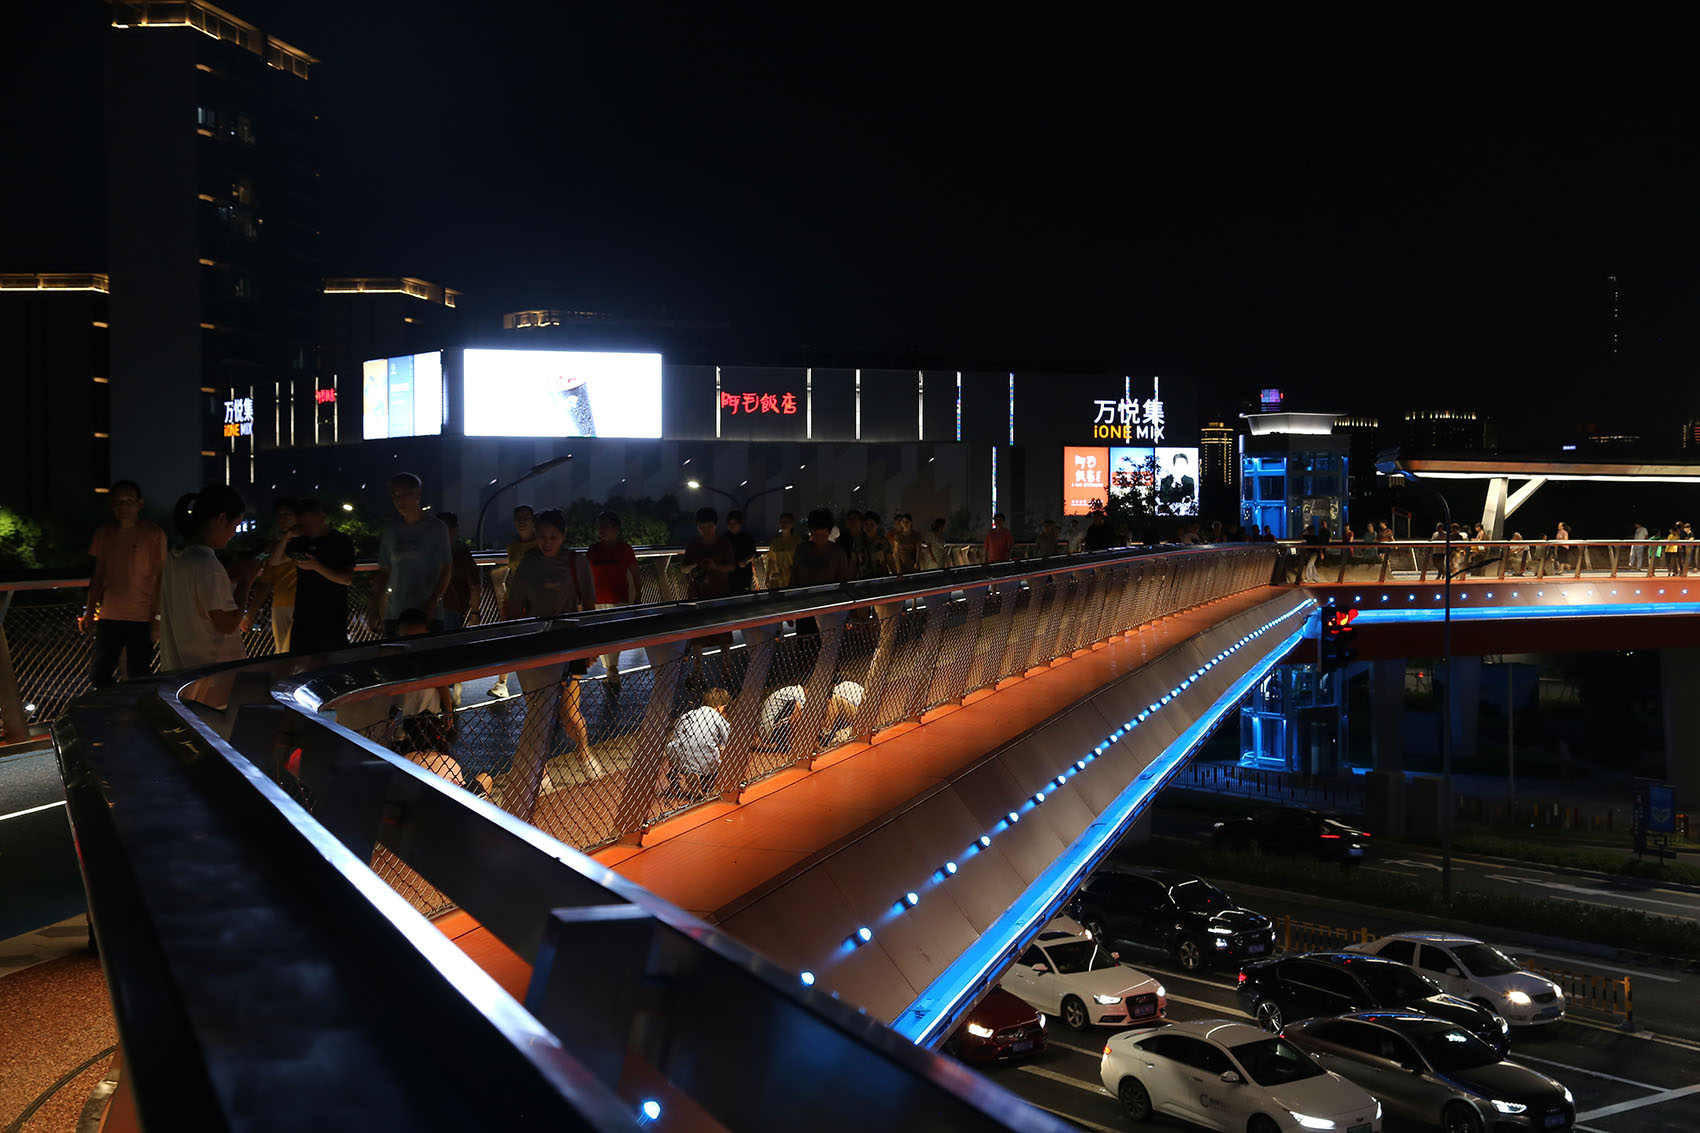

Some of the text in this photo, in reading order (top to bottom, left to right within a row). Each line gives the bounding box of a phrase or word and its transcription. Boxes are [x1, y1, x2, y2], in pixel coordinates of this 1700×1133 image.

[224, 398, 254, 423] 万悦集
[720, 391, 797, 415] 阿毛飯店
[1093, 398, 1165, 424] 万悦集
[1136, 425, 1165, 440] MIX
